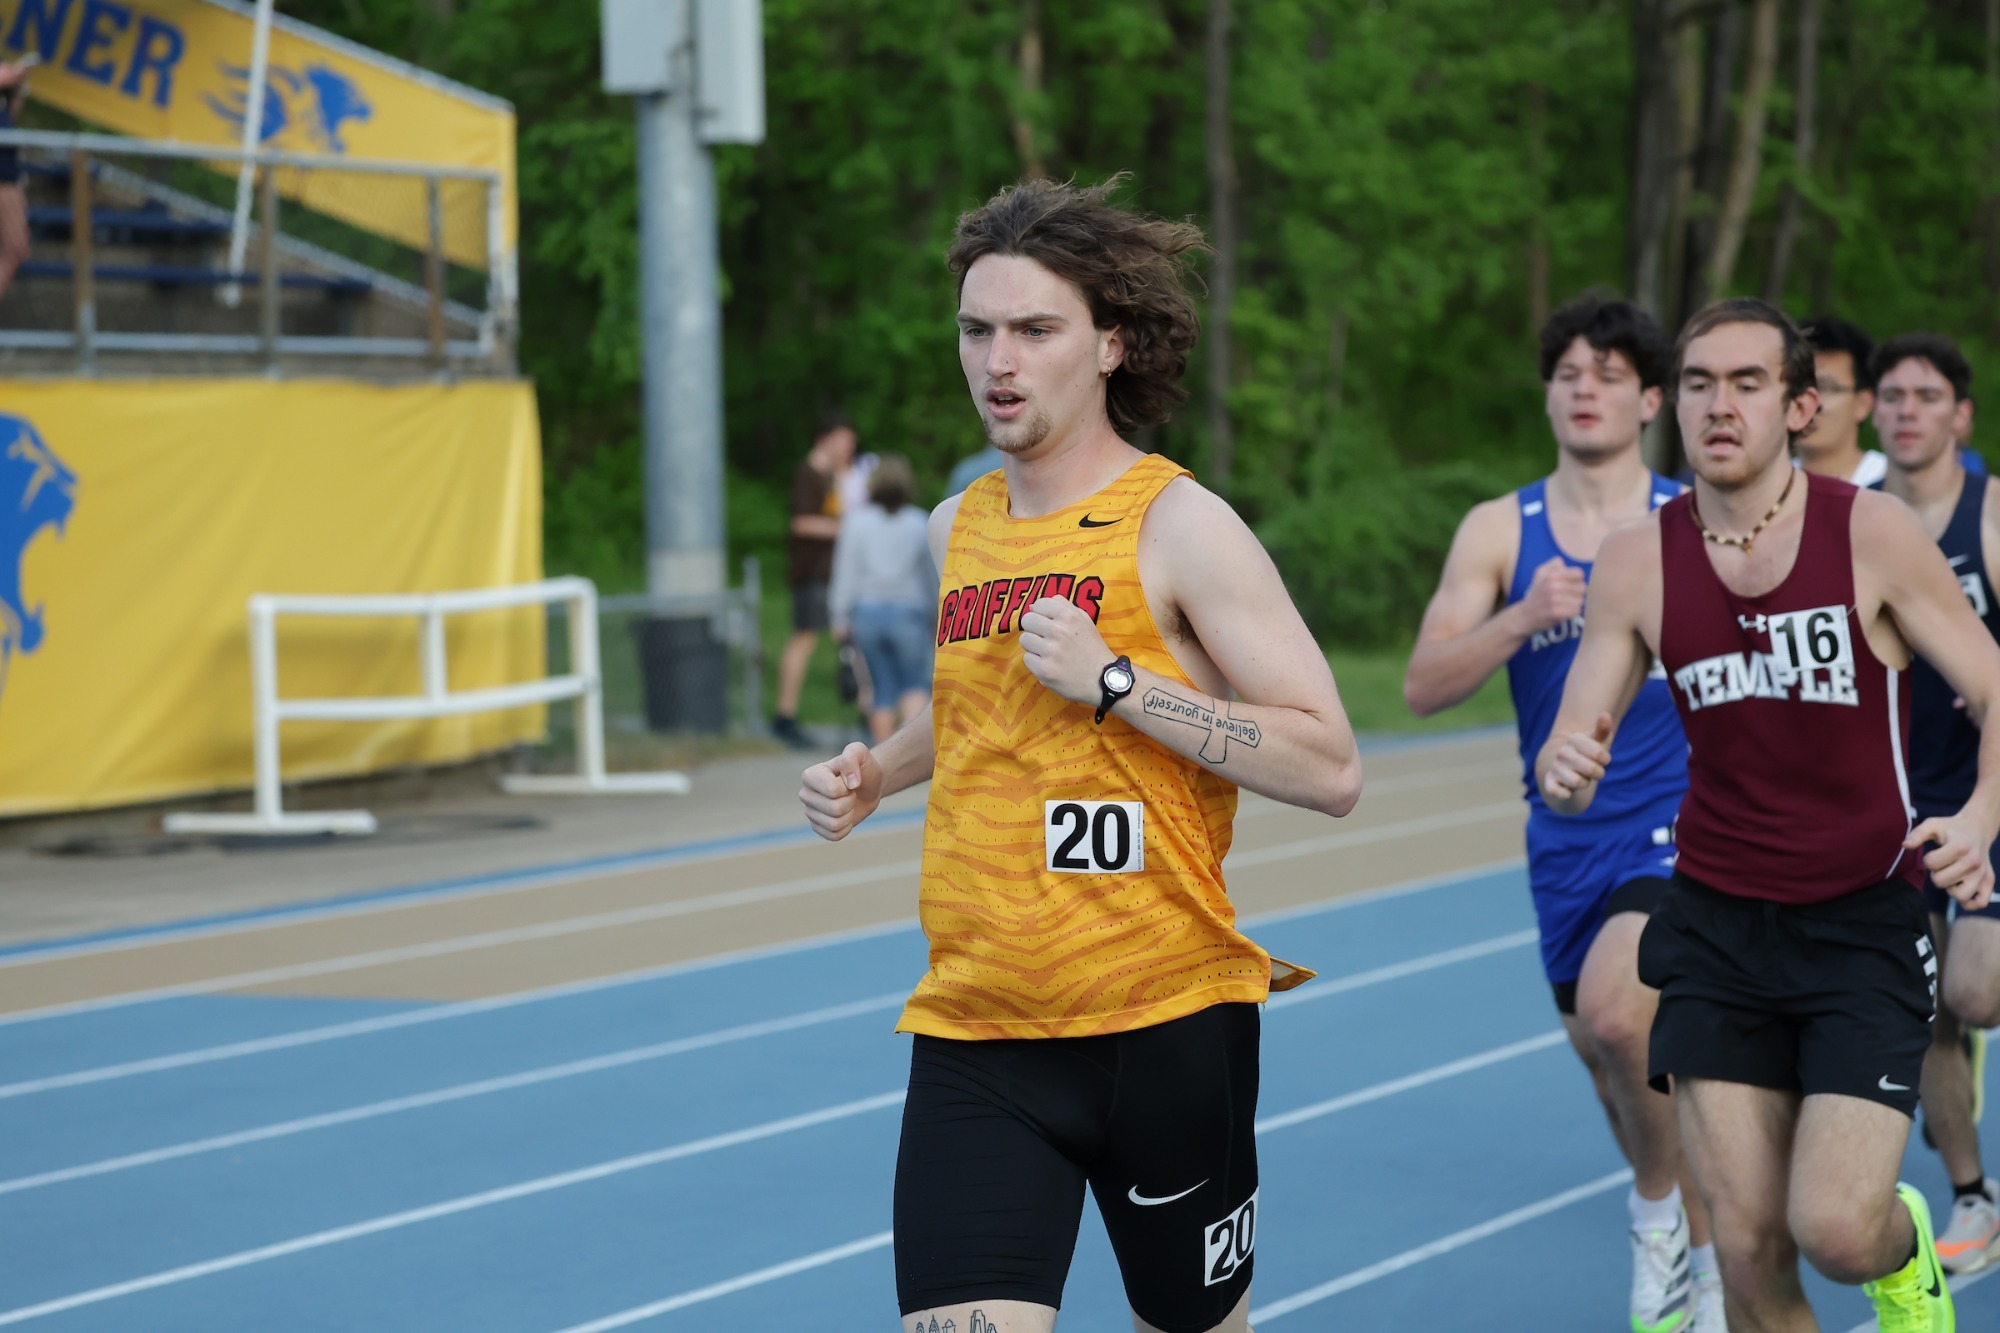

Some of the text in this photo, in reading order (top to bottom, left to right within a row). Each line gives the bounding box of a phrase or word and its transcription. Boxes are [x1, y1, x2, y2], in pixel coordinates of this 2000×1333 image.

[0, 0, 186, 108] NER
[1776, 612, 1839, 668] 16
[1674, 650, 1860, 712] TEMPLE
[1146, 695, 1256, 741] Believe in yourself
[1051, 803, 1130, 871] 20
[1210, 1200, 1254, 1281] 20
